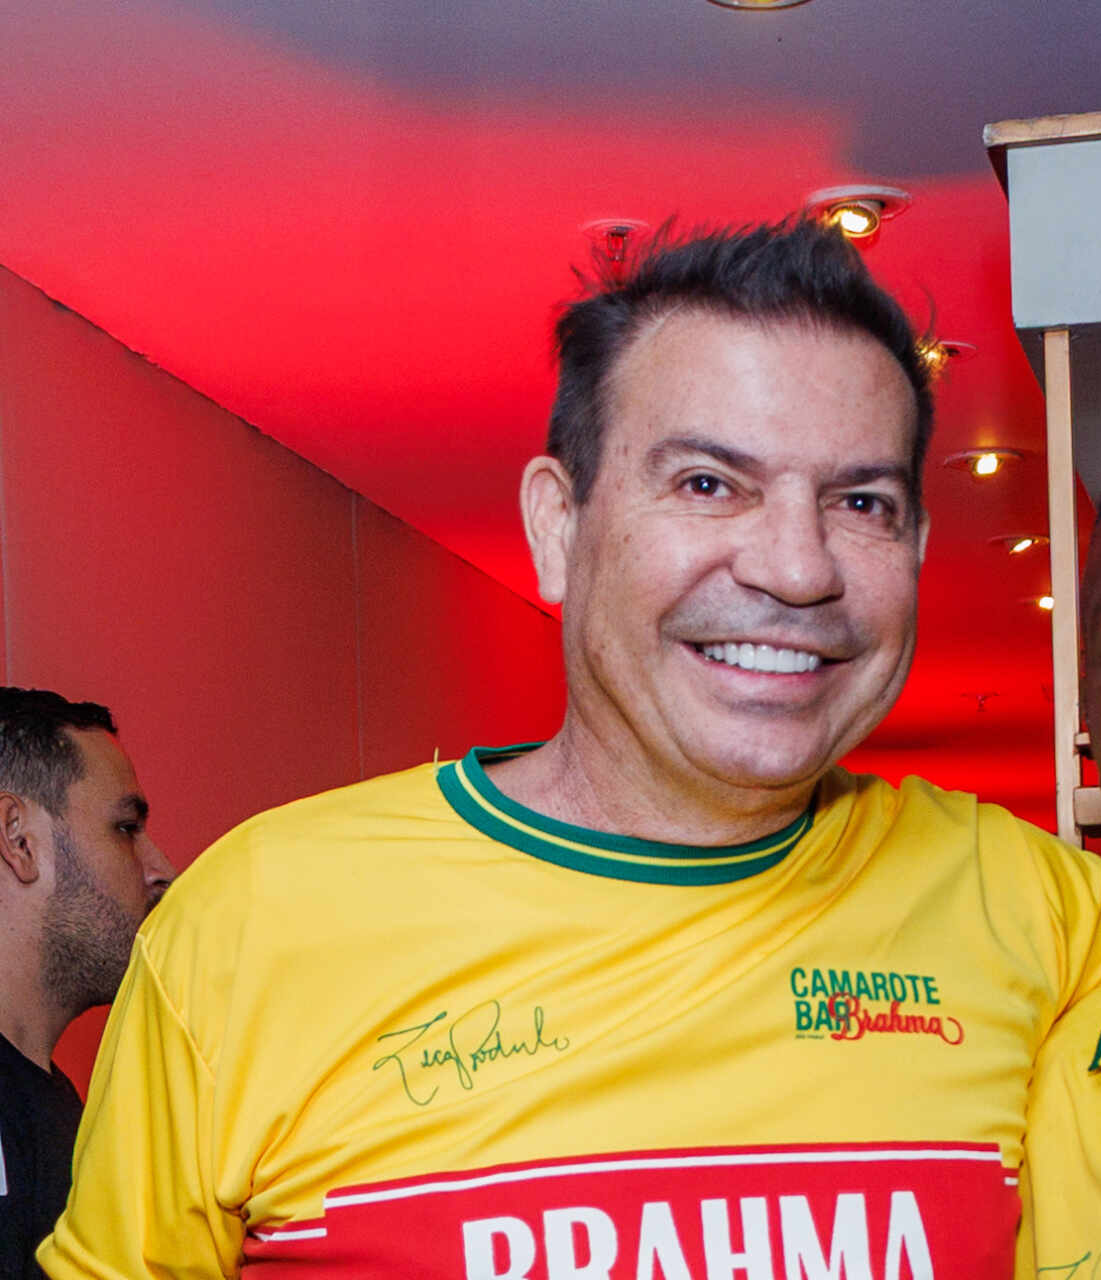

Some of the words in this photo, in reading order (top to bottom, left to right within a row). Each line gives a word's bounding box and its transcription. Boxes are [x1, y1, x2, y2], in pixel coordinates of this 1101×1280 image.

[790, 967, 941, 1006] CAMAROTE
[794, 999, 852, 1032] BAR
[827, 991, 965, 1046] Brahma
